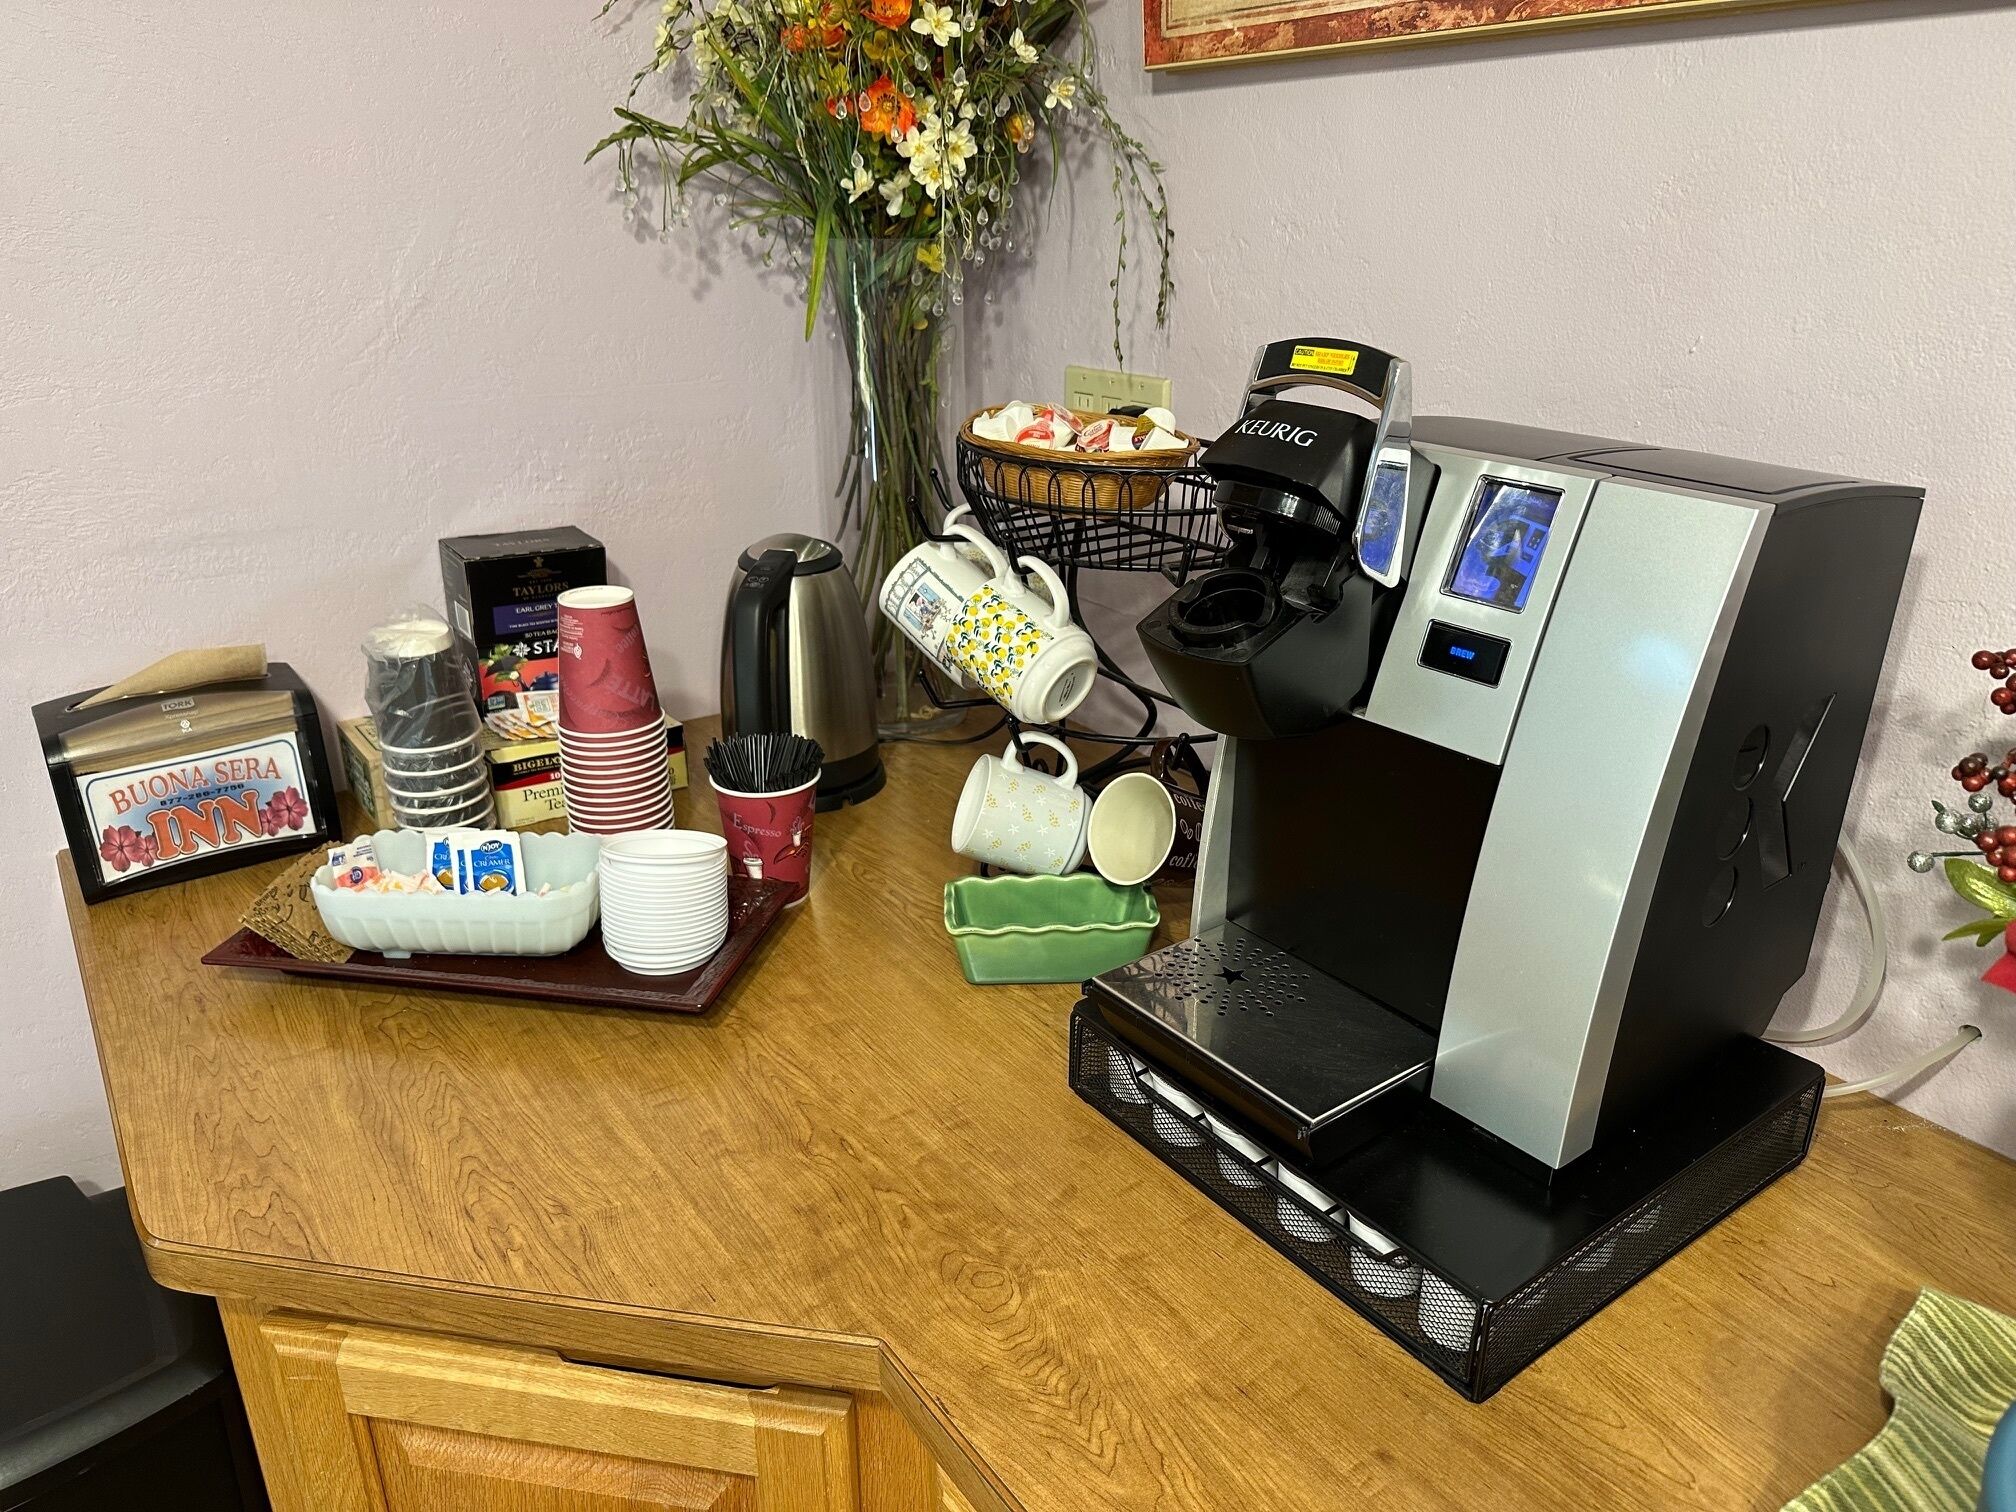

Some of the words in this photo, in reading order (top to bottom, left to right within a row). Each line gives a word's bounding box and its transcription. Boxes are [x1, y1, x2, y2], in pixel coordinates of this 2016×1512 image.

[1295, 348, 1314, 356] CAUTION
[1234, 419, 1319, 447] KEURIG
[512, 581, 570, 597] TAYLORS
[515, 606, 534, 614] EARL
[534, 603, 553, 611] GREY
[1450, 646, 1475, 660] BREW
[164, 700, 192, 710] TORK
[108, 765, 209, 815] BUONA
[214, 757, 282, 784] SERA
[146, 788, 263, 860] INN
[733, 812, 782, 838] Espresso
[473, 858, 511, 868] CREAMER
